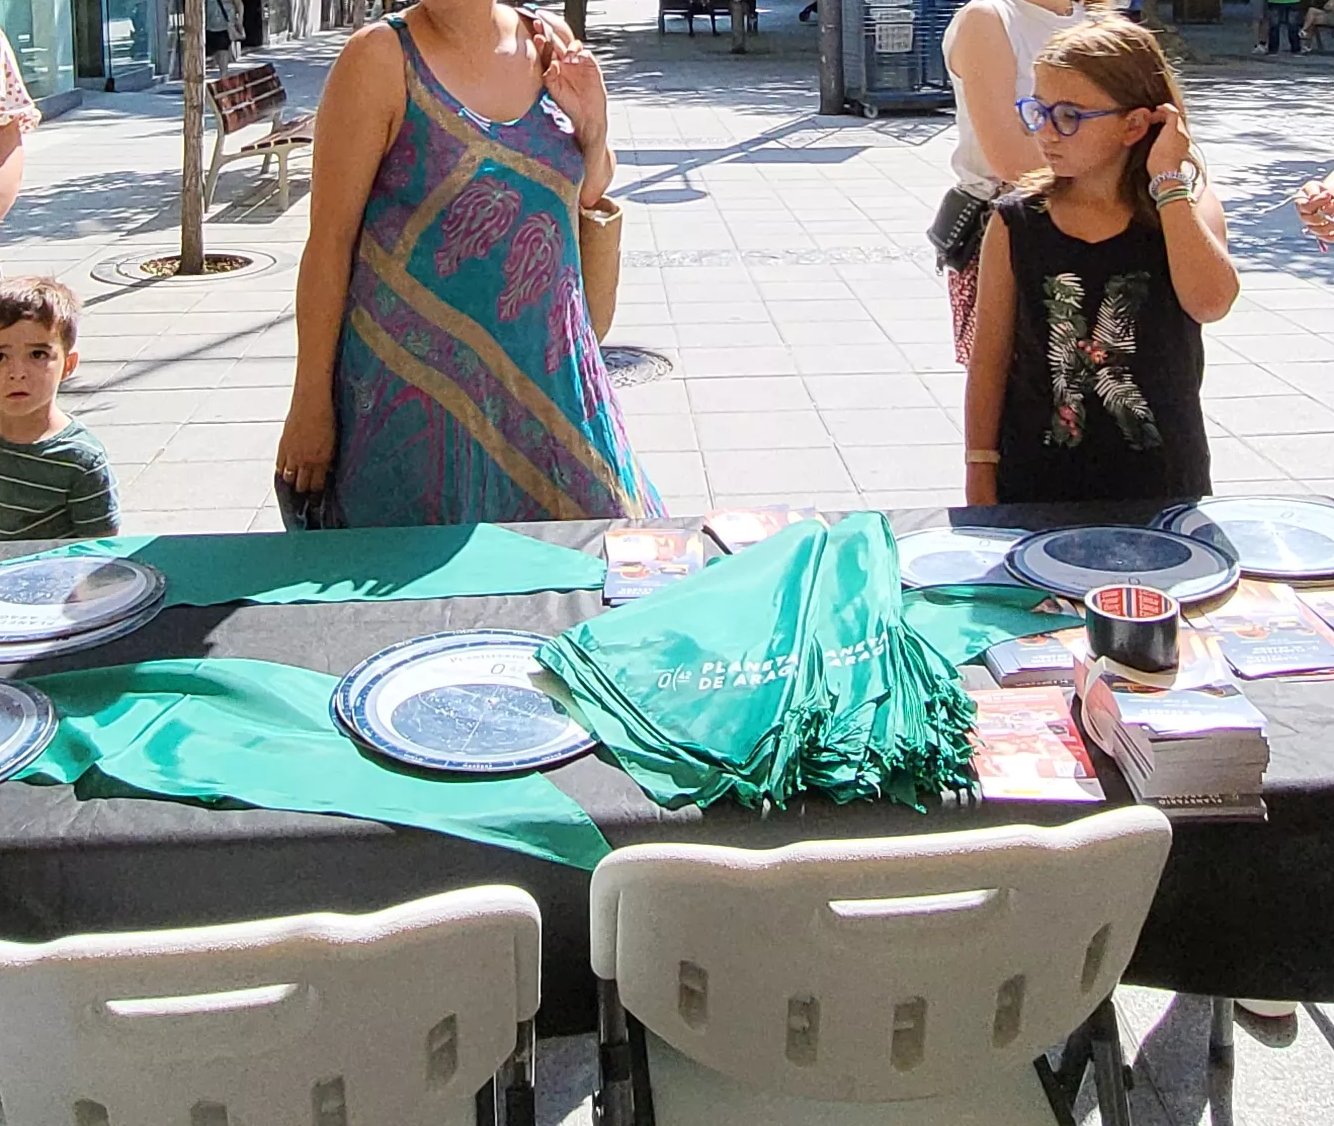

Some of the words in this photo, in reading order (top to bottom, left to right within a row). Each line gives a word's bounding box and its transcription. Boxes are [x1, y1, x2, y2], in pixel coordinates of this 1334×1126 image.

[701, 653, 799, 675] PLANETA
[698, 676, 725, 691] DE
[733, 665, 797, 688] ARAG
